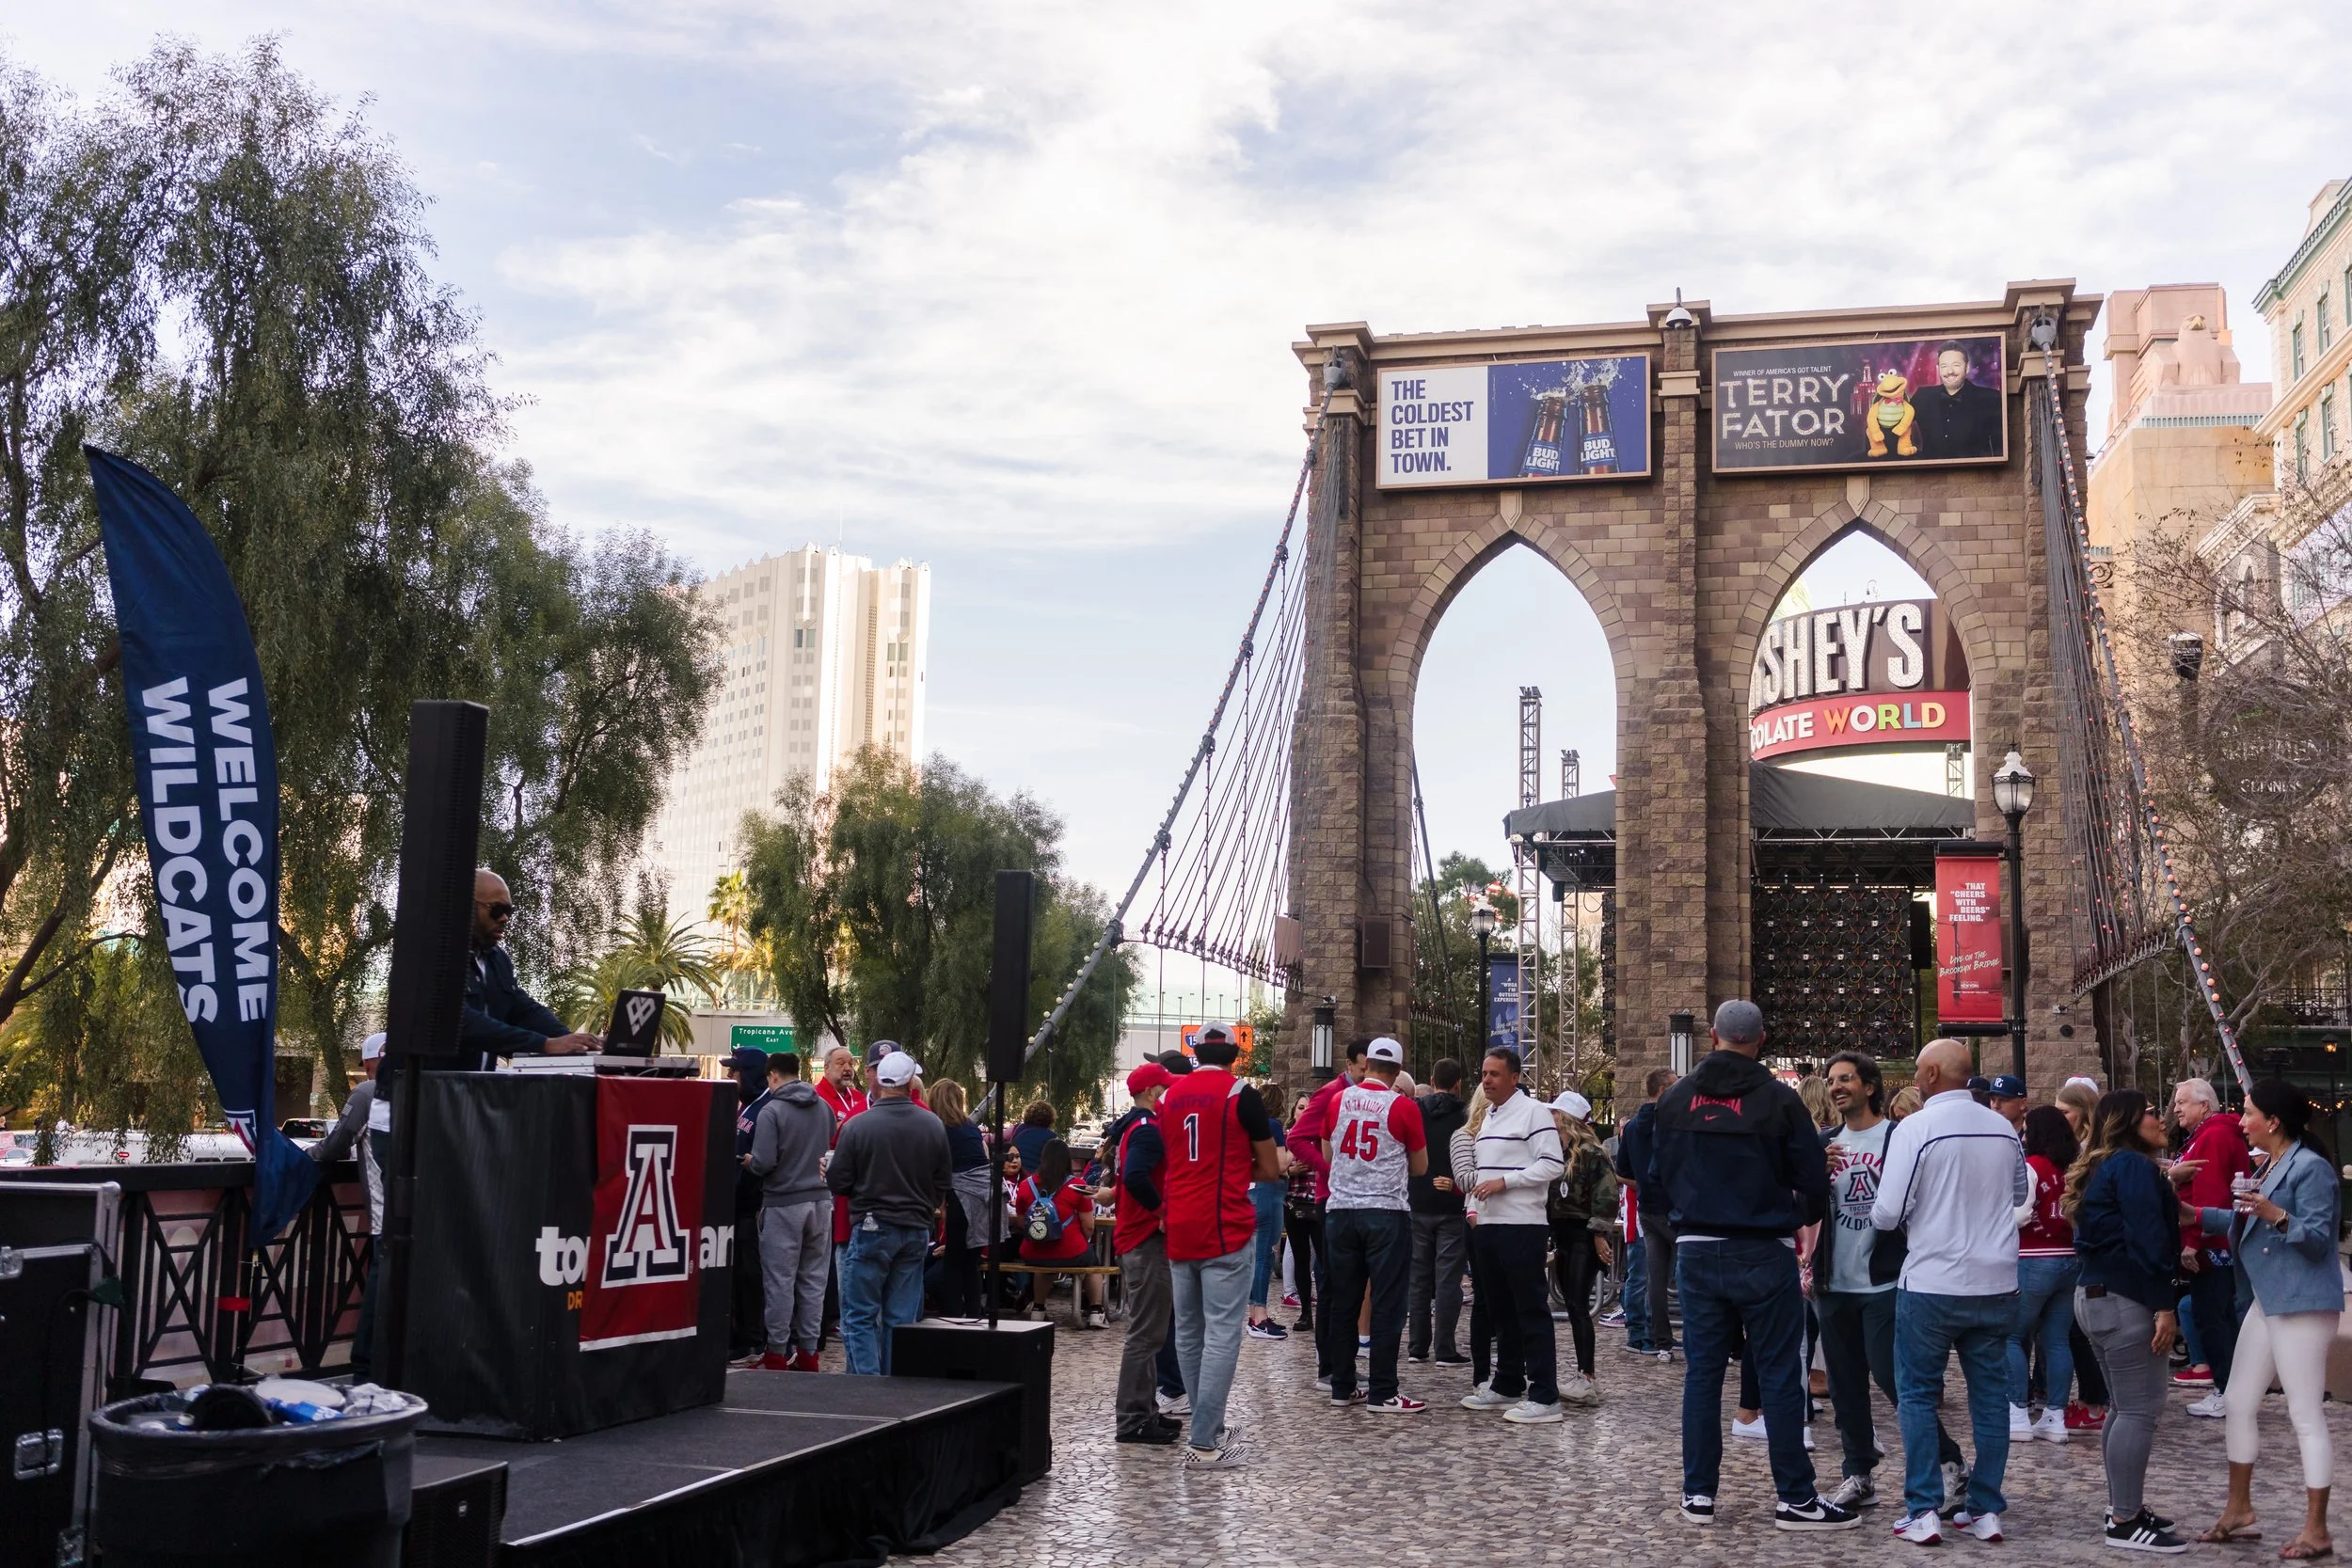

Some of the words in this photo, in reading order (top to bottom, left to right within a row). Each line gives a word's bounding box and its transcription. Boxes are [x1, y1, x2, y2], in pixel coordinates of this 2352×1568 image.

[1391, 379, 1425, 401] THE
[1720, 374, 1849, 407] TERRY
[1391, 401, 1474, 425] COLDEST
[1723, 408, 1845, 439] FATOR
[1391, 428, 1426, 450] BET
[1431, 426, 1449, 448] IN
[1583, 438, 1611, 451] BUD
[1735, 440, 1760, 450] WHO'S
[1762, 440, 1777, 449] THE
[1779, 439, 1809, 448] DUMMY
[1810, 437, 1834, 447] NOW?
[1391, 451, 1452, 473] TOWN.
[1526, 456, 1561, 471] LIGHT
[1533, 447, 1559, 460] BUD
[1581, 448, 1616, 462] LIGHT
[1823, 702, 1947, 735] WORLD
[142, 676, 218, 1023] WILDCATS
[208, 677, 270, 1022] WELCOME
[1184, 1113, 1199, 1162] 1
[1340, 1119, 1380, 1162] 45
[1845, 1171, 1875, 1202] A
[600, 1124, 691, 1289] A
